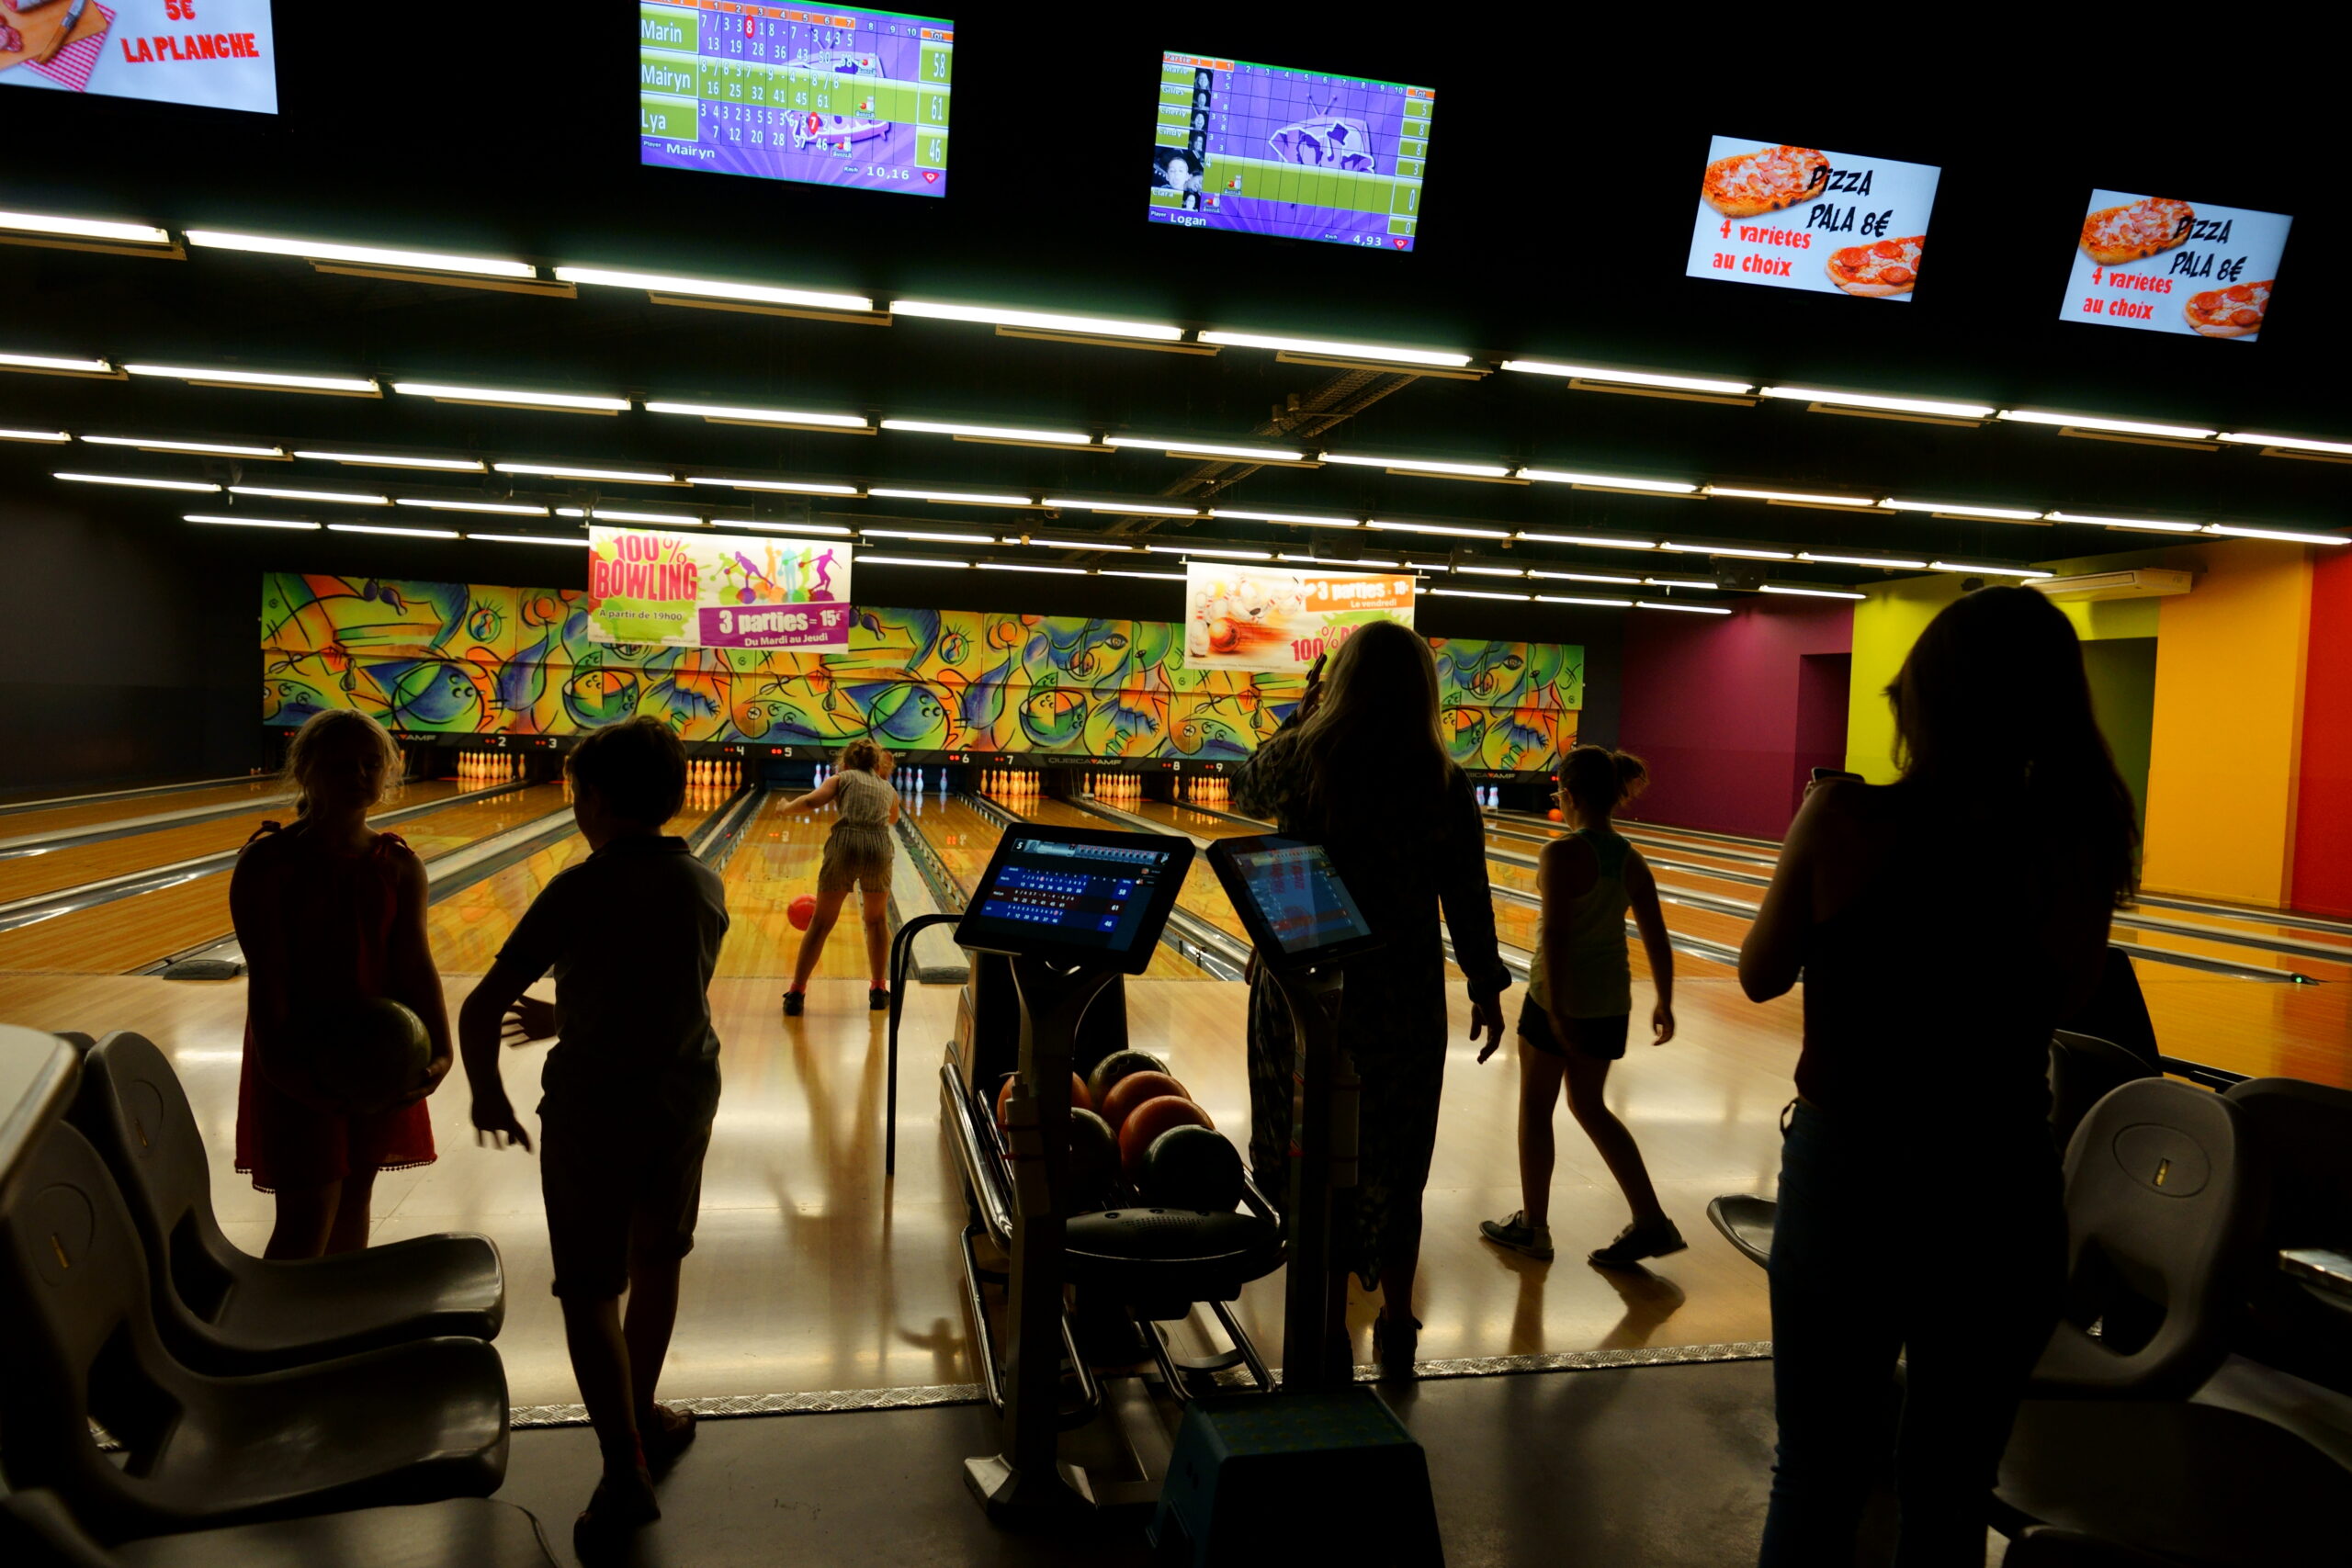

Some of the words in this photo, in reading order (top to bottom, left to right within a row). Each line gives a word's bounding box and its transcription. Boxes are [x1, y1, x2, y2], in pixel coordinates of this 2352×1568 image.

[164, 0, 196, 20] 5€
[736, 5, 741, 13] 2
[758, 7, 763, 16] 3
[803, 14, 808, 22] 5
[824, 17, 830, 25] 6
[868, 22, 874, 30] 8
[890, 26, 896, 34] 9
[907, 28, 917, 36] 10
[930, 31, 944, 40] Tot
[119, 37, 154, 63] LA
[153, 33, 260, 62] PLANCHE
[641, 18, 683, 43] Marin
[701, 15, 707, 28] 7
[724, 17, 729, 31] 3
[737, 19, 742, 32] 3
[760, 22, 764, 35] 1
[769, 23, 775, 37] 8
[813, 28, 819, 42] 3
[825, 31, 831, 42] 4
[847, 33, 853, 47] 5
[933, 52, 945, 78] 58
[707, 37, 719, 51] 13
[730, 39, 742, 53] 19
[752, 42, 764, 56] 28
[775, 45, 786, 59] 36
[797, 48, 808, 62] 43
[819, 51, 831, 64] 50
[841, 53, 853, 68] 58
[1165, 53, 1192, 63] Partie
[641, 64, 691, 93] Mairyn
[932, 96, 943, 120] 61
[707, 81, 719, 95] 16
[729, 84, 741, 97] 25
[752, 86, 763, 100] 32
[774, 89, 785, 103] 41
[796, 92, 808, 106] 45
[817, 95, 829, 108] 61
[641, 108, 666, 133] Lya
[701, 103, 707, 117] 3
[713, 105, 719, 118] 4
[723, 106, 729, 119] 3
[735, 107, 741, 121] 2
[745, 108, 751, 122] 3
[757, 110, 763, 123] 5
[767, 111, 773, 125] 5
[929, 139, 941, 163] 46
[713, 125, 718, 139] 7
[729, 128, 741, 141] 12
[751, 130, 763, 143] 20
[773, 132, 785, 146] 28
[816, 138, 828, 152] 46
[666, 143, 715, 160] Mairyn
[1170, 213, 1206, 227] Logan
[1805, 203, 1856, 233] PALA
[1860, 209, 1894, 237] 8€
[1720, 220, 1732, 240] 4
[1739, 225, 1812, 250] varietes
[1713, 253, 1735, 270] au
[1742, 254, 1792, 277] choix
[2168, 251, 2215, 279] PALA
[2217, 255, 2248, 283] 8€
[2092, 266, 2103, 286] 4
[2109, 272, 2174, 295] varietes
[2083, 298, 2104, 314] au
[2109, 299, 2154, 321] choix
[594, 558, 697, 602] BOWLING
[1317, 581, 1329, 600] 3
[1362, 599, 1396, 607] vendredi
[608, 610, 635, 620] partir
[639, 611, 650, 619] de
[653, 612, 682, 621] 19h00
[718, 609, 733, 634] 3
[738, 611, 808, 635] parties
[744, 637, 759, 647] Du
[761, 635, 787, 646] Mardi
[789, 635, 801, 643] au
[803, 633, 828, 643] Jeudi
[498, 736, 506, 747] 2
[548, 738, 557, 749] 3
[737, 746, 744, 755] 4
[785, 747, 792, 757] 5
[962, 754, 970, 763] 6
[1007, 755, 1013, 764] 7
[1173, 761, 1180, 771] 8
[1216, 762, 1223, 772] 9
